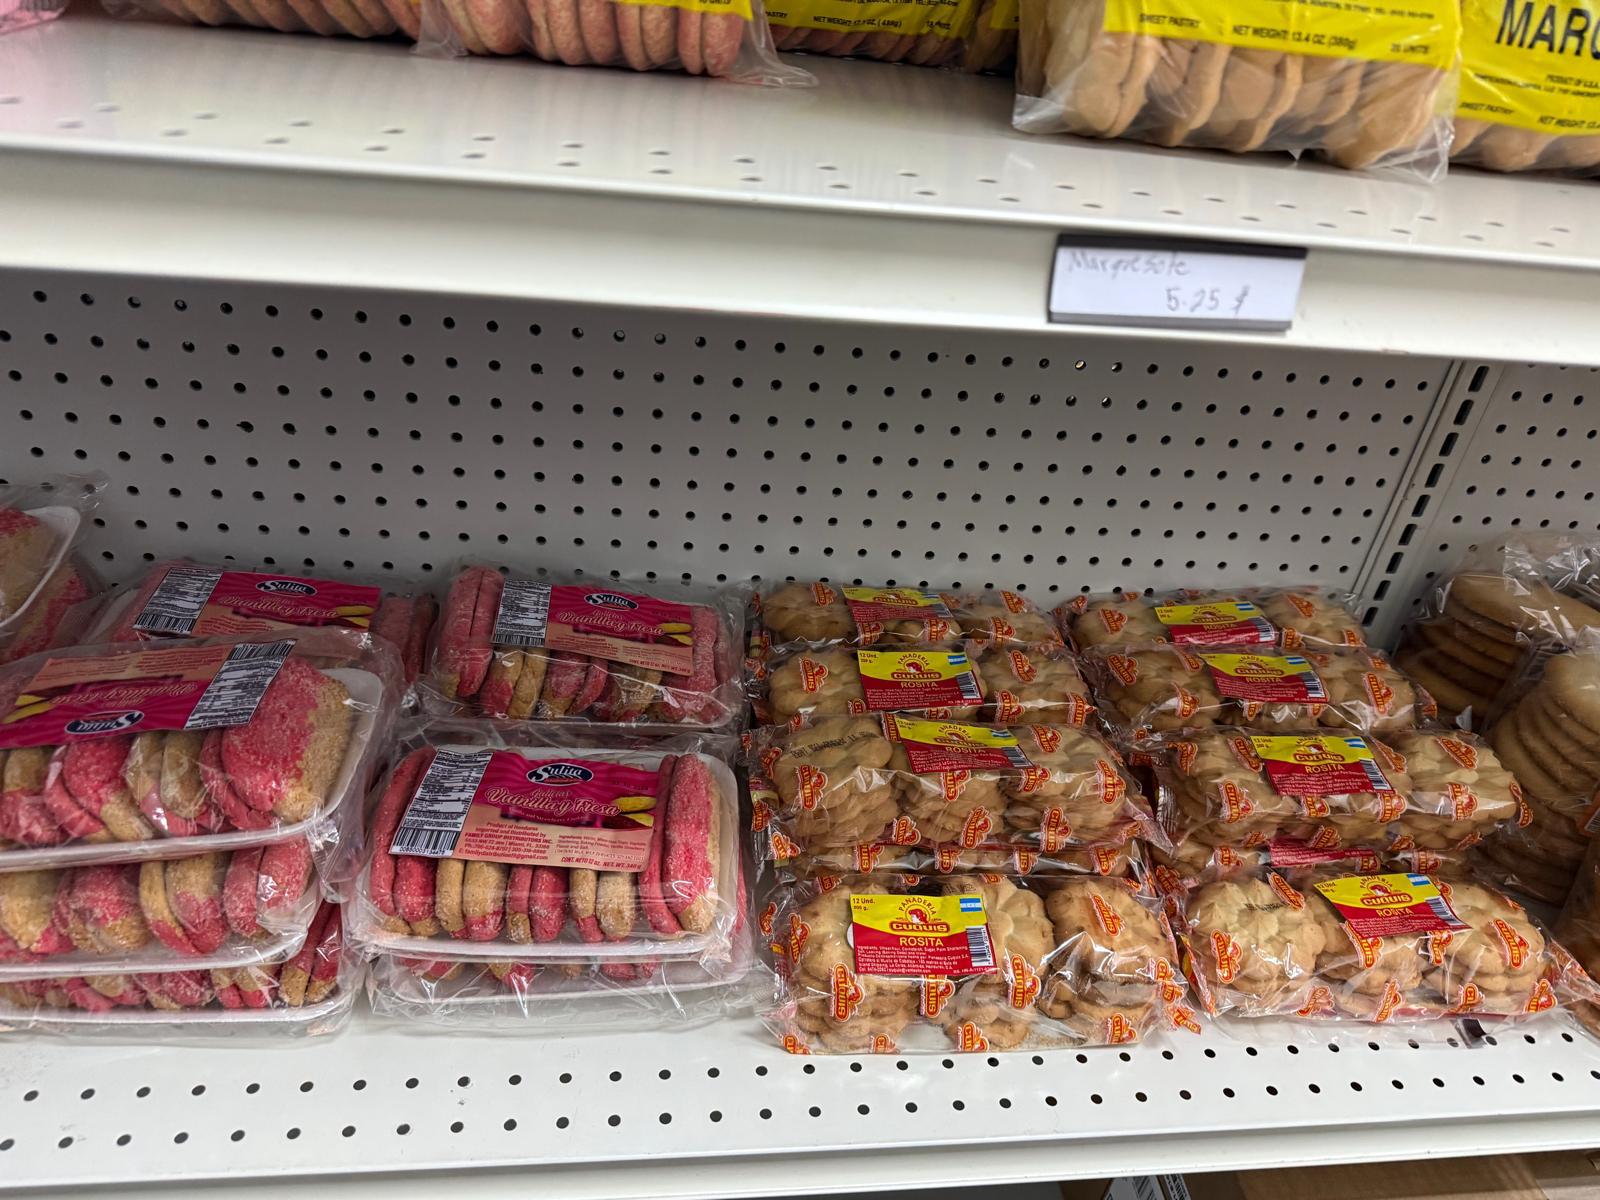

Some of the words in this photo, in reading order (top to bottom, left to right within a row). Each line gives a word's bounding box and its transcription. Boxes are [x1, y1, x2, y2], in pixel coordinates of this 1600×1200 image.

[263, 579, 308, 593] Sulita
[588, 593, 630, 607] Sulita
[900, 681, 938, 689] ROSITA
[1369, 675, 1386, 713] CUQUIS
[1444, 738, 1473, 768] CUQUIS
[529, 763, 582, 783] Sulita
[1305, 764, 1345, 774] ROSITA
[802, 766, 812, 809] CUQUIS
[485, 787, 557, 812] Vainilla
[574, 798, 621, 817] Fresa
[503, 835, 541, 843] DISTRIBUTORS
[1050, 808, 1058, 850] CUQUIS
[1272, 876, 1301, 907] CUQUIS
[1362, 895, 1411, 906] CUQUIS
[899, 897, 938, 916] PANADERIA
[1095, 897, 1117, 934] CUQUIS
[1377, 908, 1414, 917] ROSITA
[892, 923, 948, 932] CUQUIS
[900, 937, 944, 947] ROSITA
[1497, 921, 1521, 967] CUQUIS
[1213, 930, 1231, 980] CUQUIS
[836, 966, 847, 1019] CUQUIS
[1012, 957, 1023, 1006] CUQUIS
